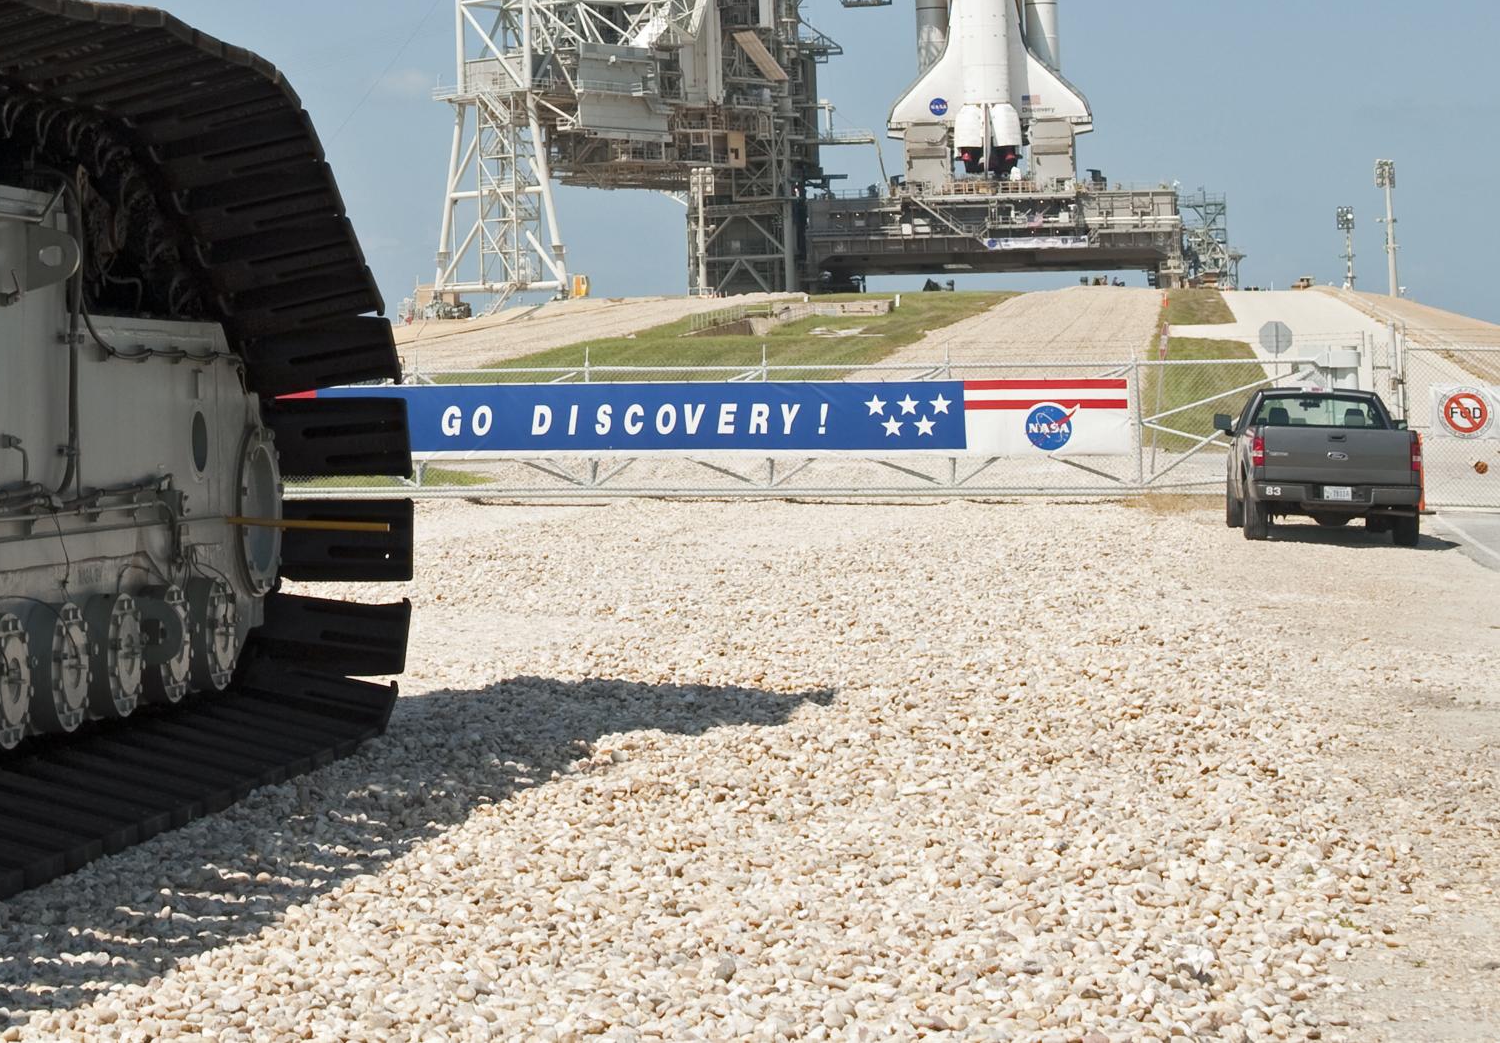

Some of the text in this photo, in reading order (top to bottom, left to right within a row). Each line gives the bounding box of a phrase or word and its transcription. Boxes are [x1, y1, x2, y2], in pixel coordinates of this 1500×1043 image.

[1021, 106, 1055, 114] Discovery
[1450, 406, 1483, 420] FOD
[440, 404, 493, 437] GO
[1028, 422, 1070, 434] NASA
[1265, 486, 1282, 496] 83
